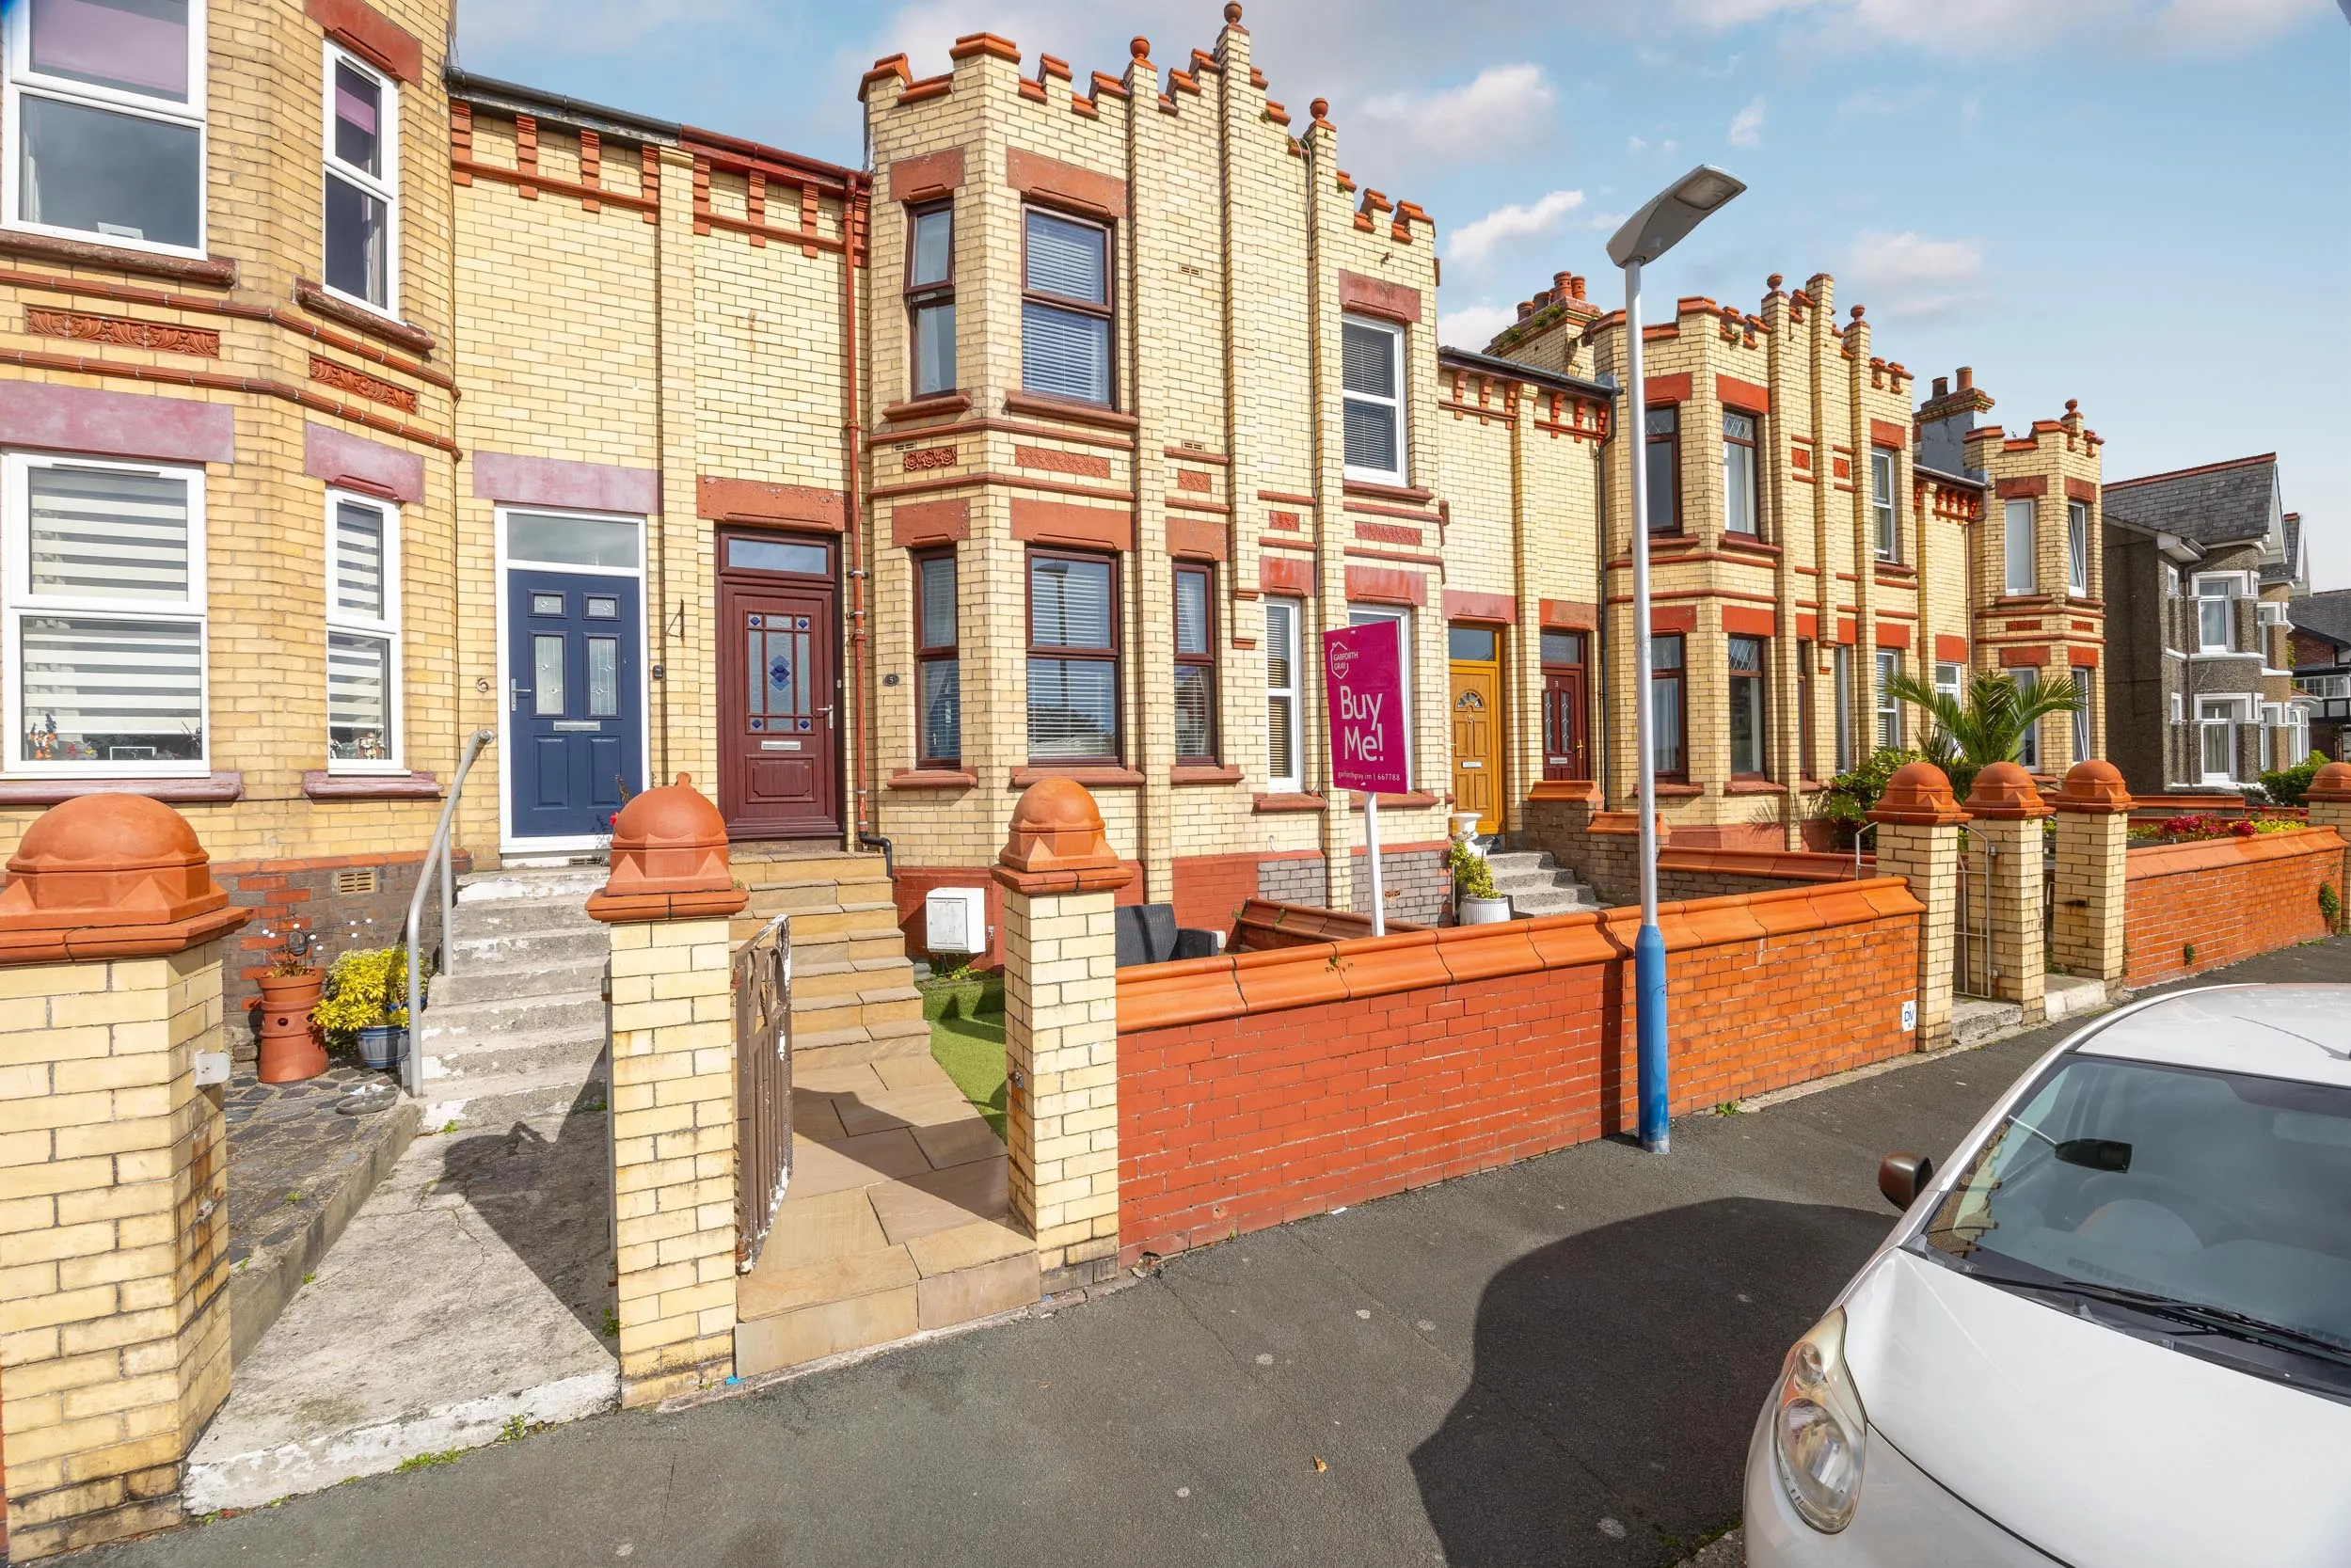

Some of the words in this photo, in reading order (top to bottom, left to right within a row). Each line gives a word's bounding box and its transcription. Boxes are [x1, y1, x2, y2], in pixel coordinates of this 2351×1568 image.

[1333, 651, 1358, 661] GARFORTH
[1334, 662, 1346, 671] GRAY
[476, 677, 489, 692] 6
[1340, 686, 1383, 730] Buy
[1344, 723, 1384, 761] Me!
[1377, 773, 1401, 782] 667788
[1904, 1009, 1914, 1022] DV
